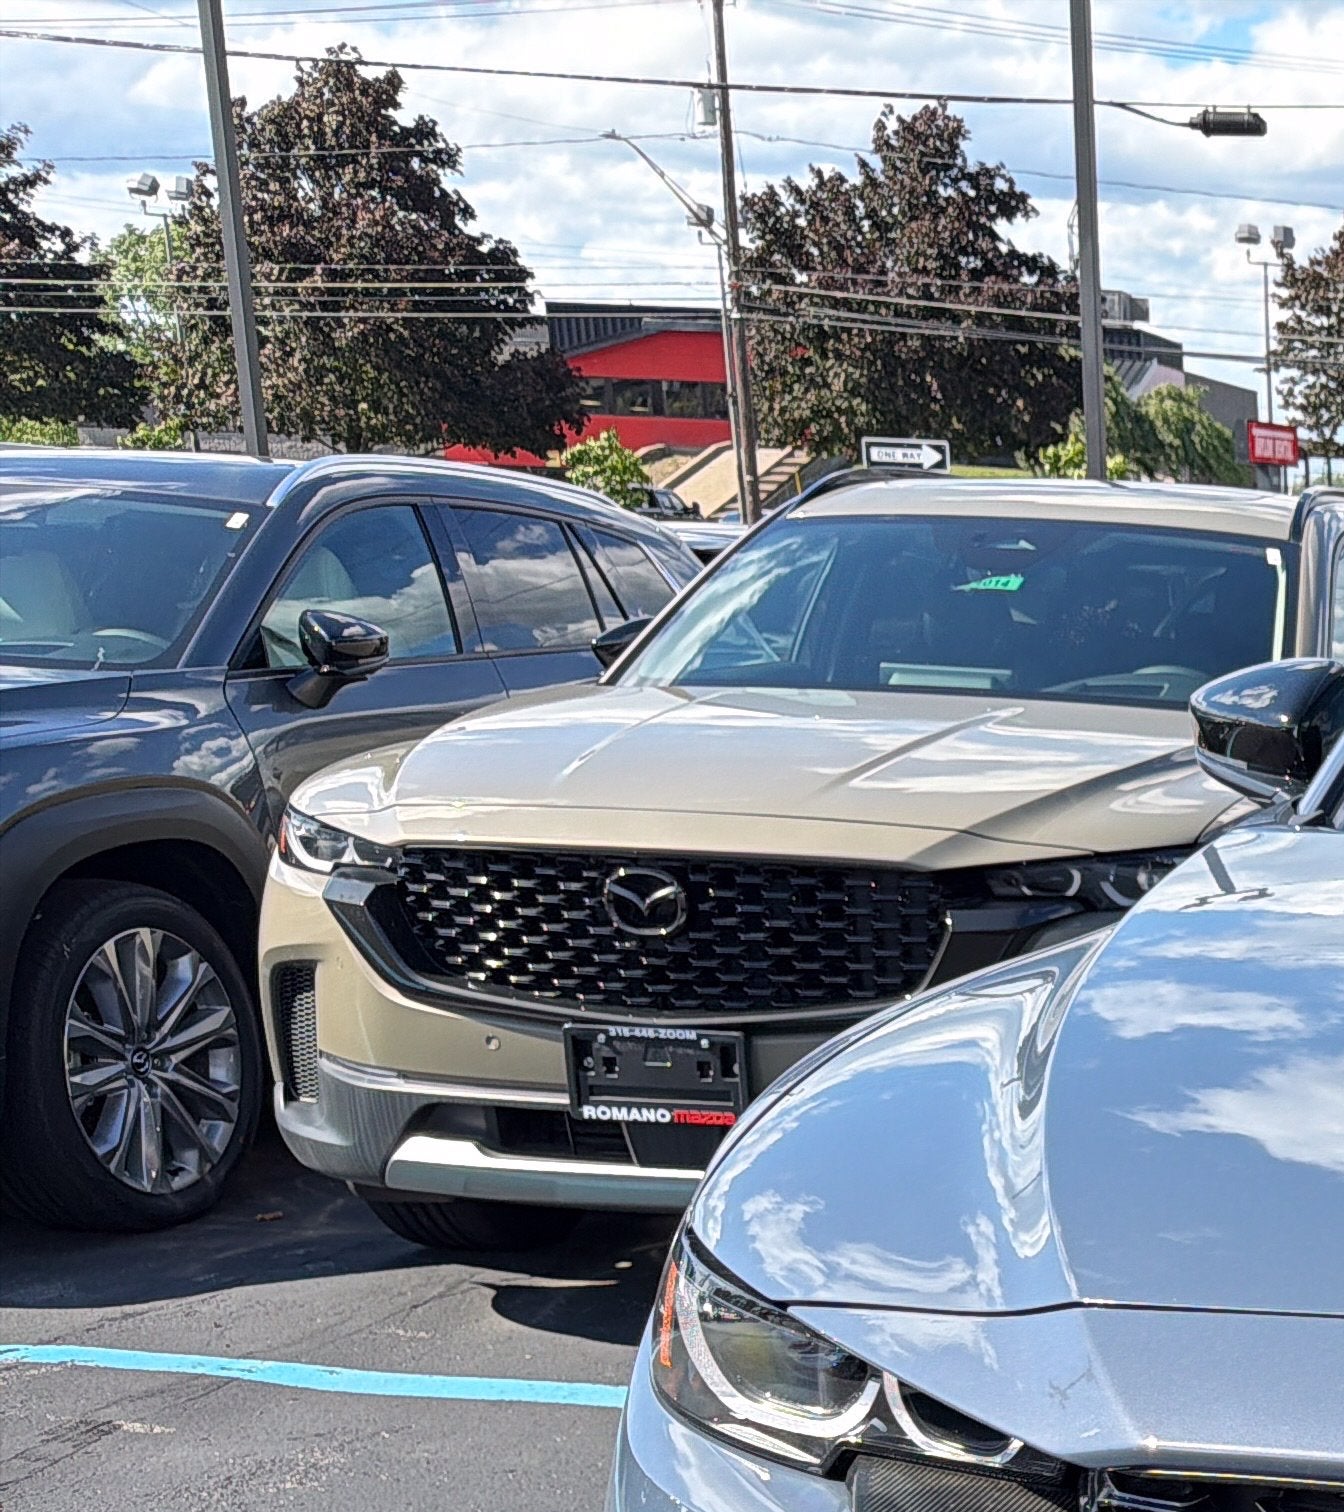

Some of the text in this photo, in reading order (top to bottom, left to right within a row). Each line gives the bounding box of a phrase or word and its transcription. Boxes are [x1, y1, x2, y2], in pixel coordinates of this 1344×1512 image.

[877, 451, 922, 460] ONE WAY
[582, 1105, 672, 1123] ROMANO
